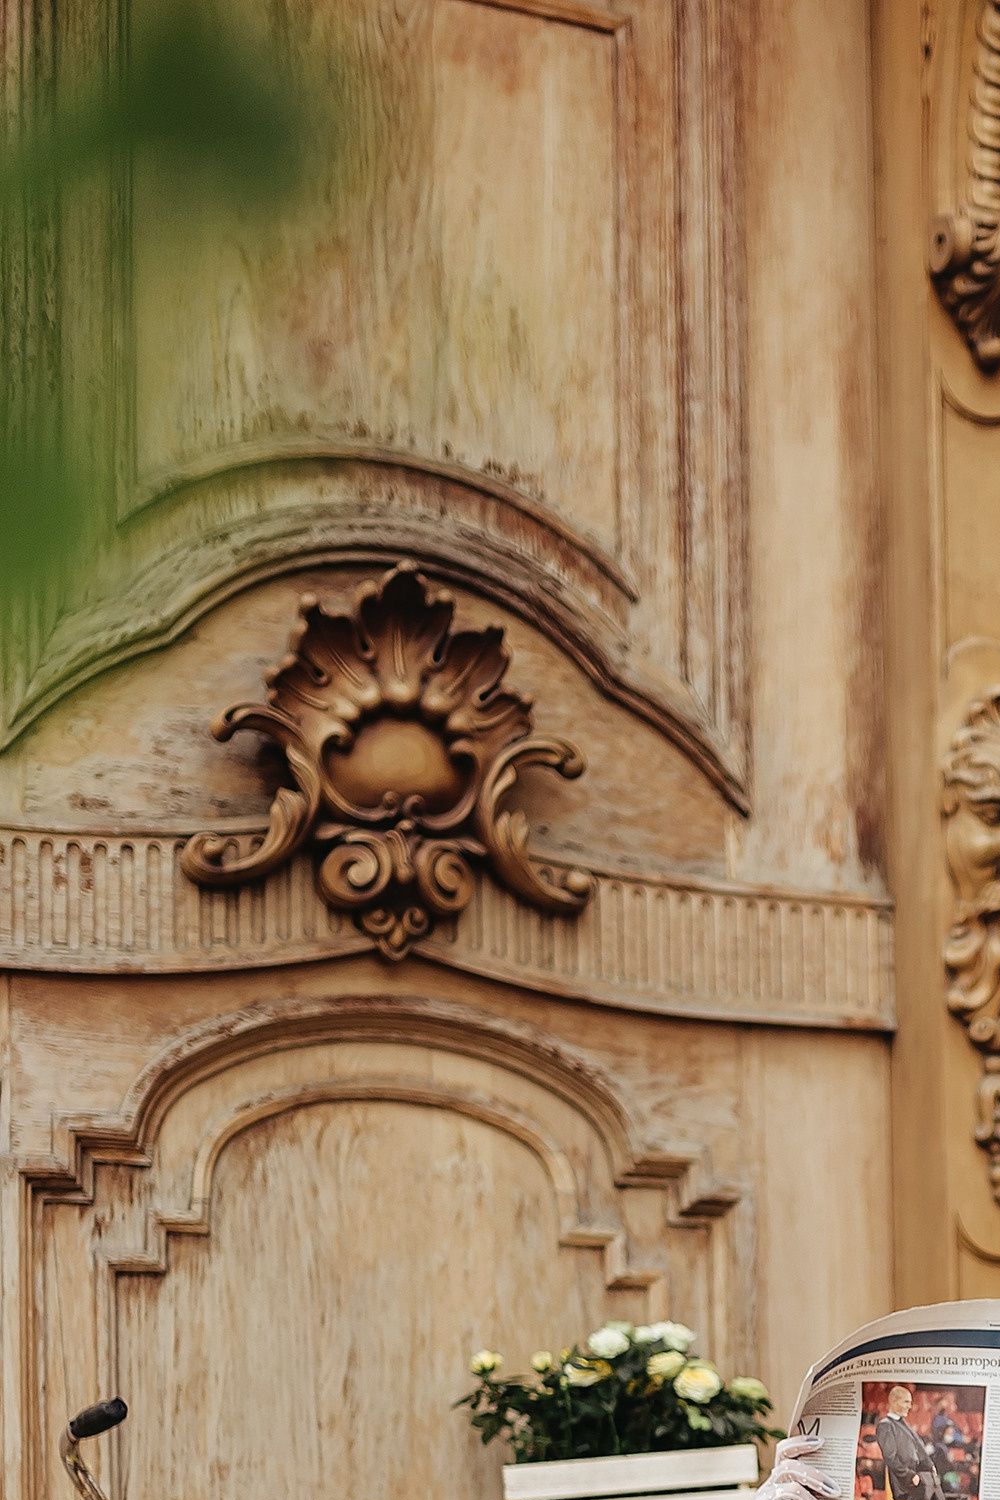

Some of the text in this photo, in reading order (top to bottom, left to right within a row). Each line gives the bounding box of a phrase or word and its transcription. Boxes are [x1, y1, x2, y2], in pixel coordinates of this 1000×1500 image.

[856, 1356, 895, 1368] Зидан
[899, 1356, 940, 1365] пошел
[943, 1357, 958, 1365] на
